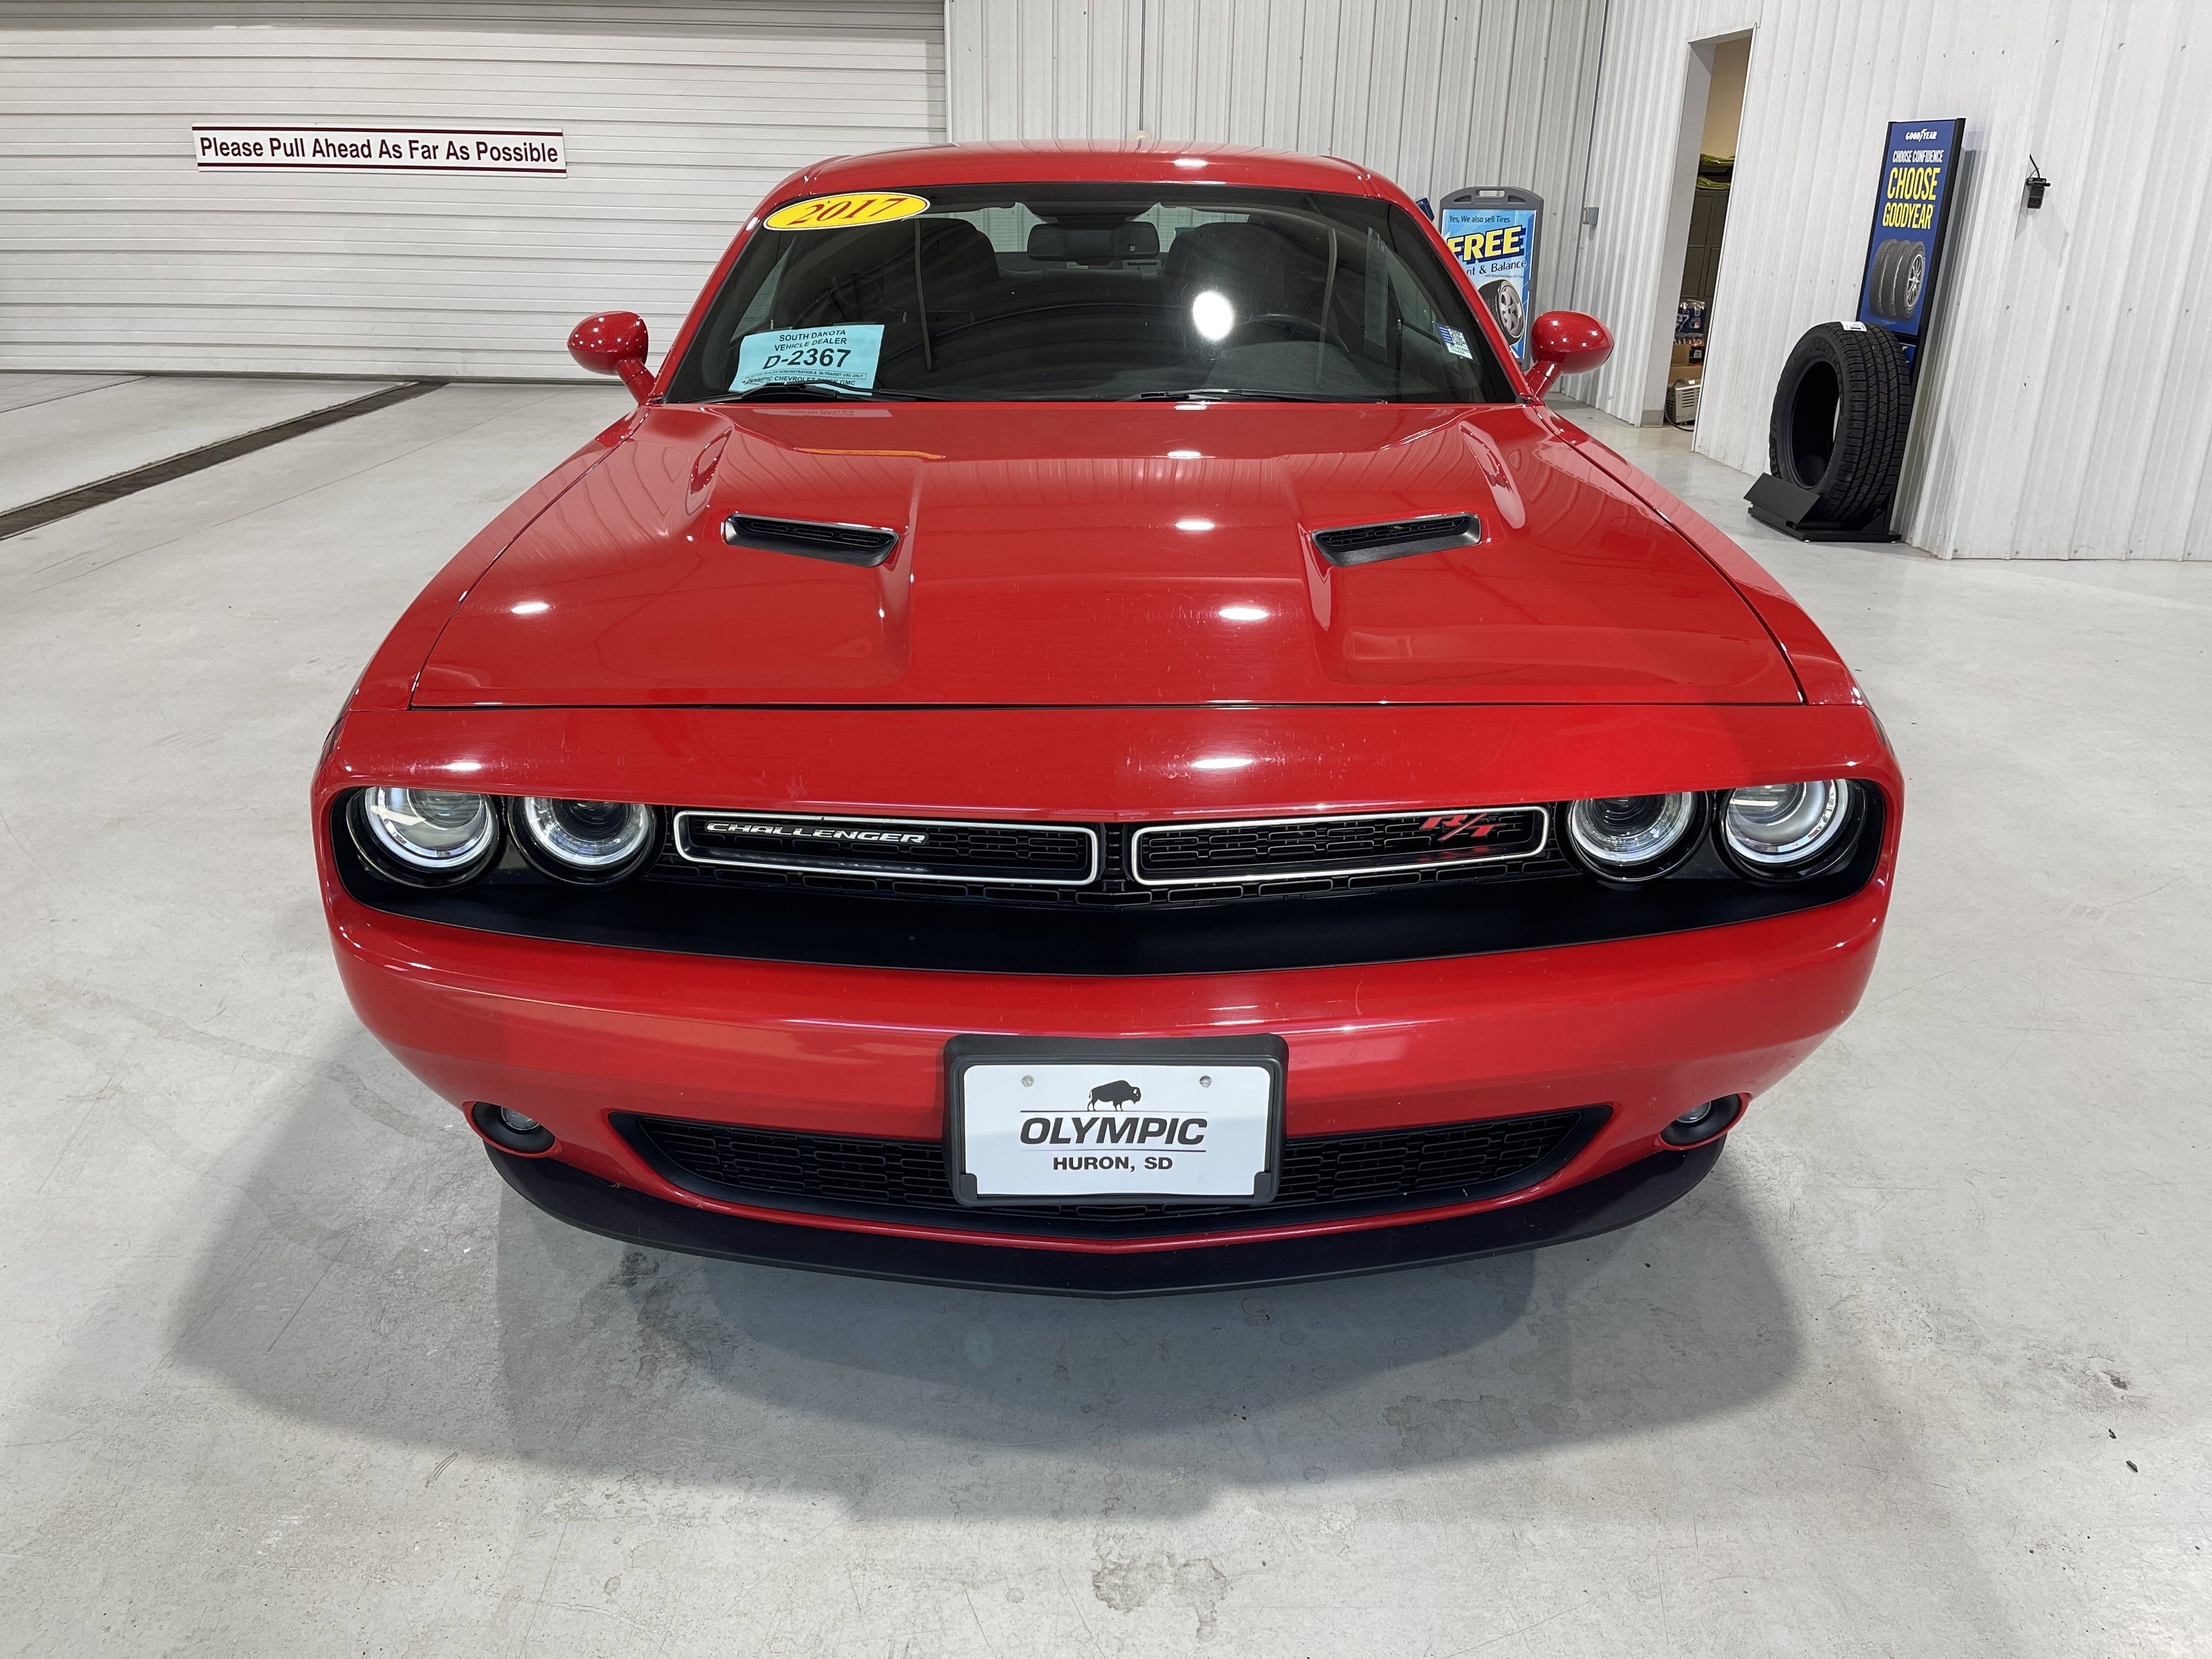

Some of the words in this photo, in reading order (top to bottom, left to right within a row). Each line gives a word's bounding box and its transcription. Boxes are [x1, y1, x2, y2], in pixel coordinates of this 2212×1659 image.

[1905, 129, 1937, 142] GOODYEAR
[200, 137, 263, 157] Please
[269, 138, 305, 157] Pull
[312, 138, 372, 158] Ahead
[379, 139, 403, 159] As
[408, 139, 439, 160] Far
[445, 140, 470, 160] As
[476, 141, 558, 162] Possible
[1892, 150, 1912, 163] CHOOSE
[1912, 149, 1944, 163] CONFIDENCE
[1887, 167, 1941, 200] CHOOSE
[786, 198, 909, 225] 2017
[1449, 215, 1460, 223] Yes,
[1882, 202, 1934, 229] GOODYEAR
[1447, 225, 1522, 261] FREE
[1479, 264, 1487, 274] &
[1491, 261, 1527, 273] Balance
[774, 341, 810, 351] VEHICLE
[812, 337, 847, 346] DEALER
[779, 333, 809, 342] SOUTH
[811, 330, 846, 339] DAKOTA
[762, 348, 851, 370] D-2367
[706, 822, 926, 843] CHALLENGER
[1419, 812, 1506, 842] R/T
[1020, 1116, 1208, 1146] OLYMPIC
[1053, 1156, 1135, 1172] HURON,
[1144, 1156, 1173, 1170] SD
